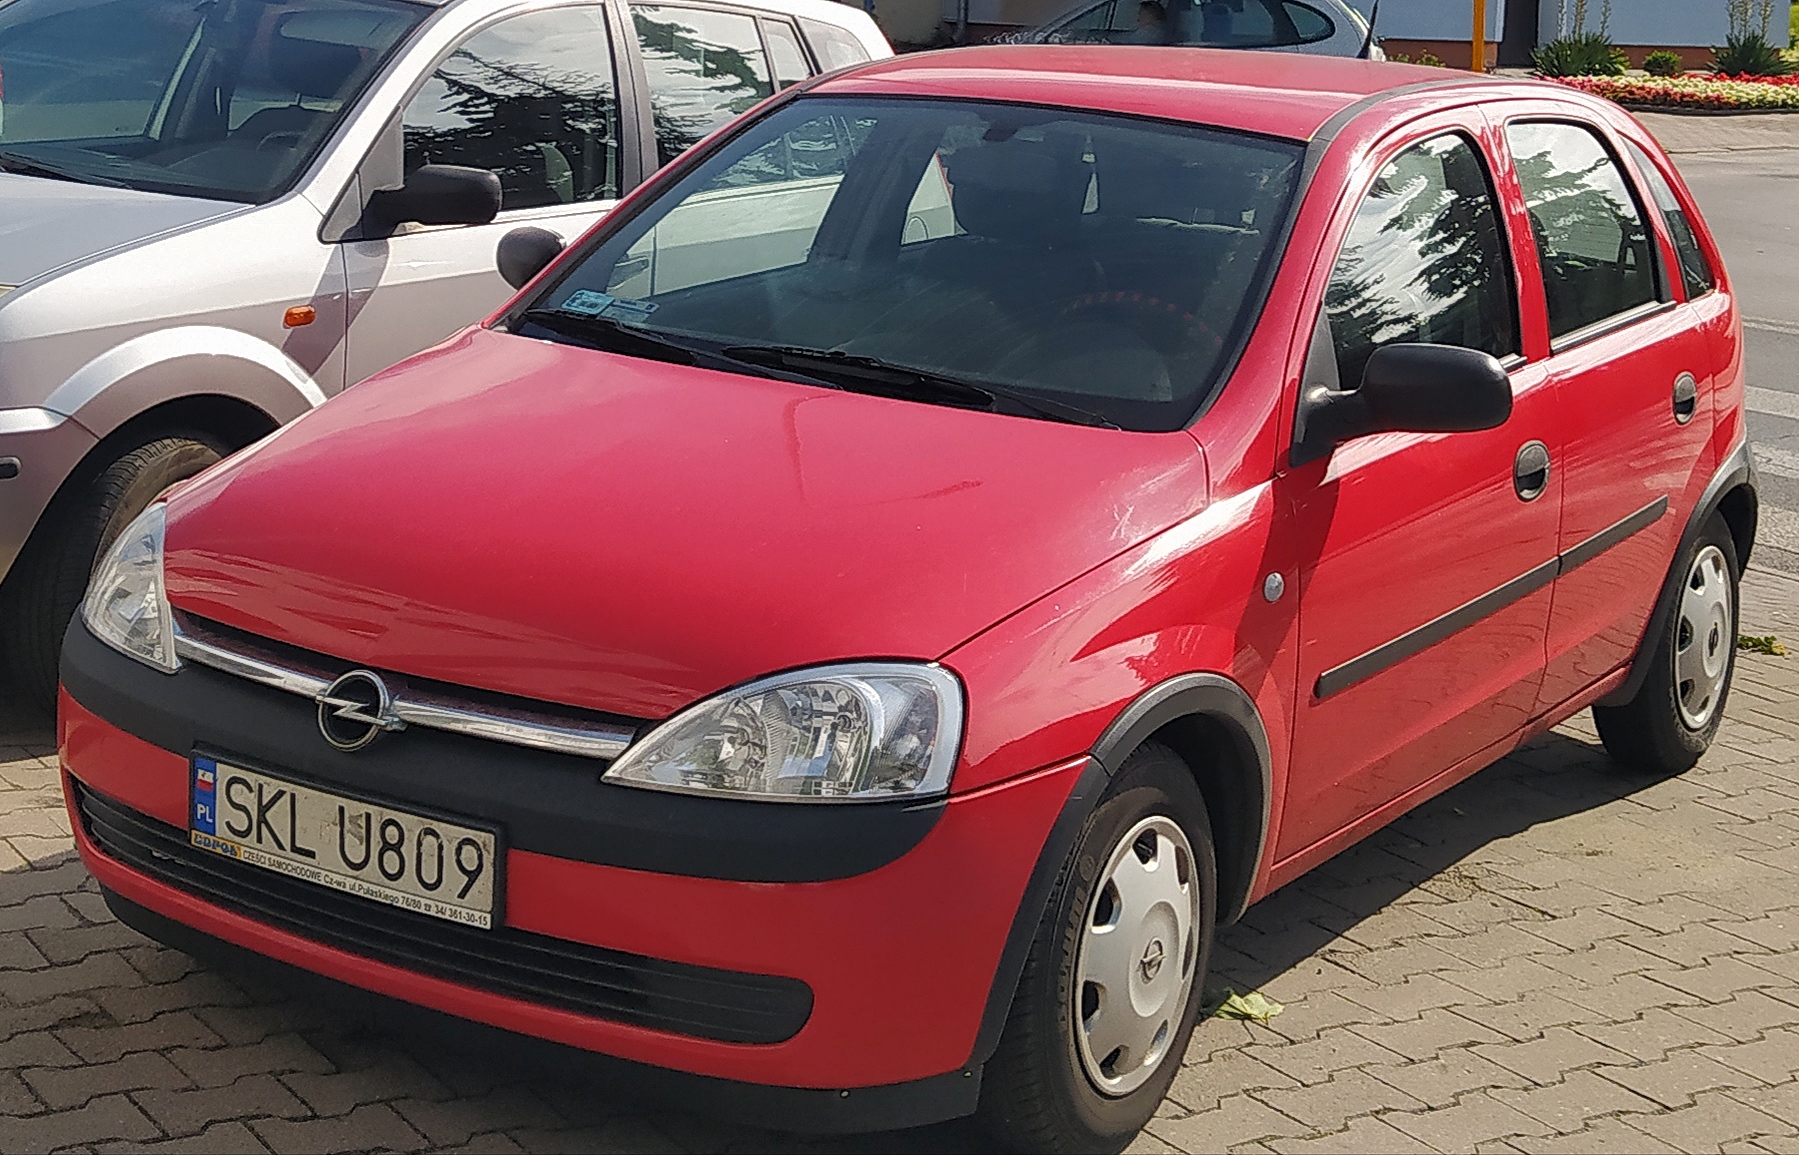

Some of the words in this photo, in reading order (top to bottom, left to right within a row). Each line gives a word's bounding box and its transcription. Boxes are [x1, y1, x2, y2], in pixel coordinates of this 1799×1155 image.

[197, 804, 213, 823] PL
[225, 776, 316, 859] SKL
[338, 805, 484, 900] U809
[268, 856, 322, 881] SAMOCHODOWE
[448, 908, 488, 926] 361-30-15
